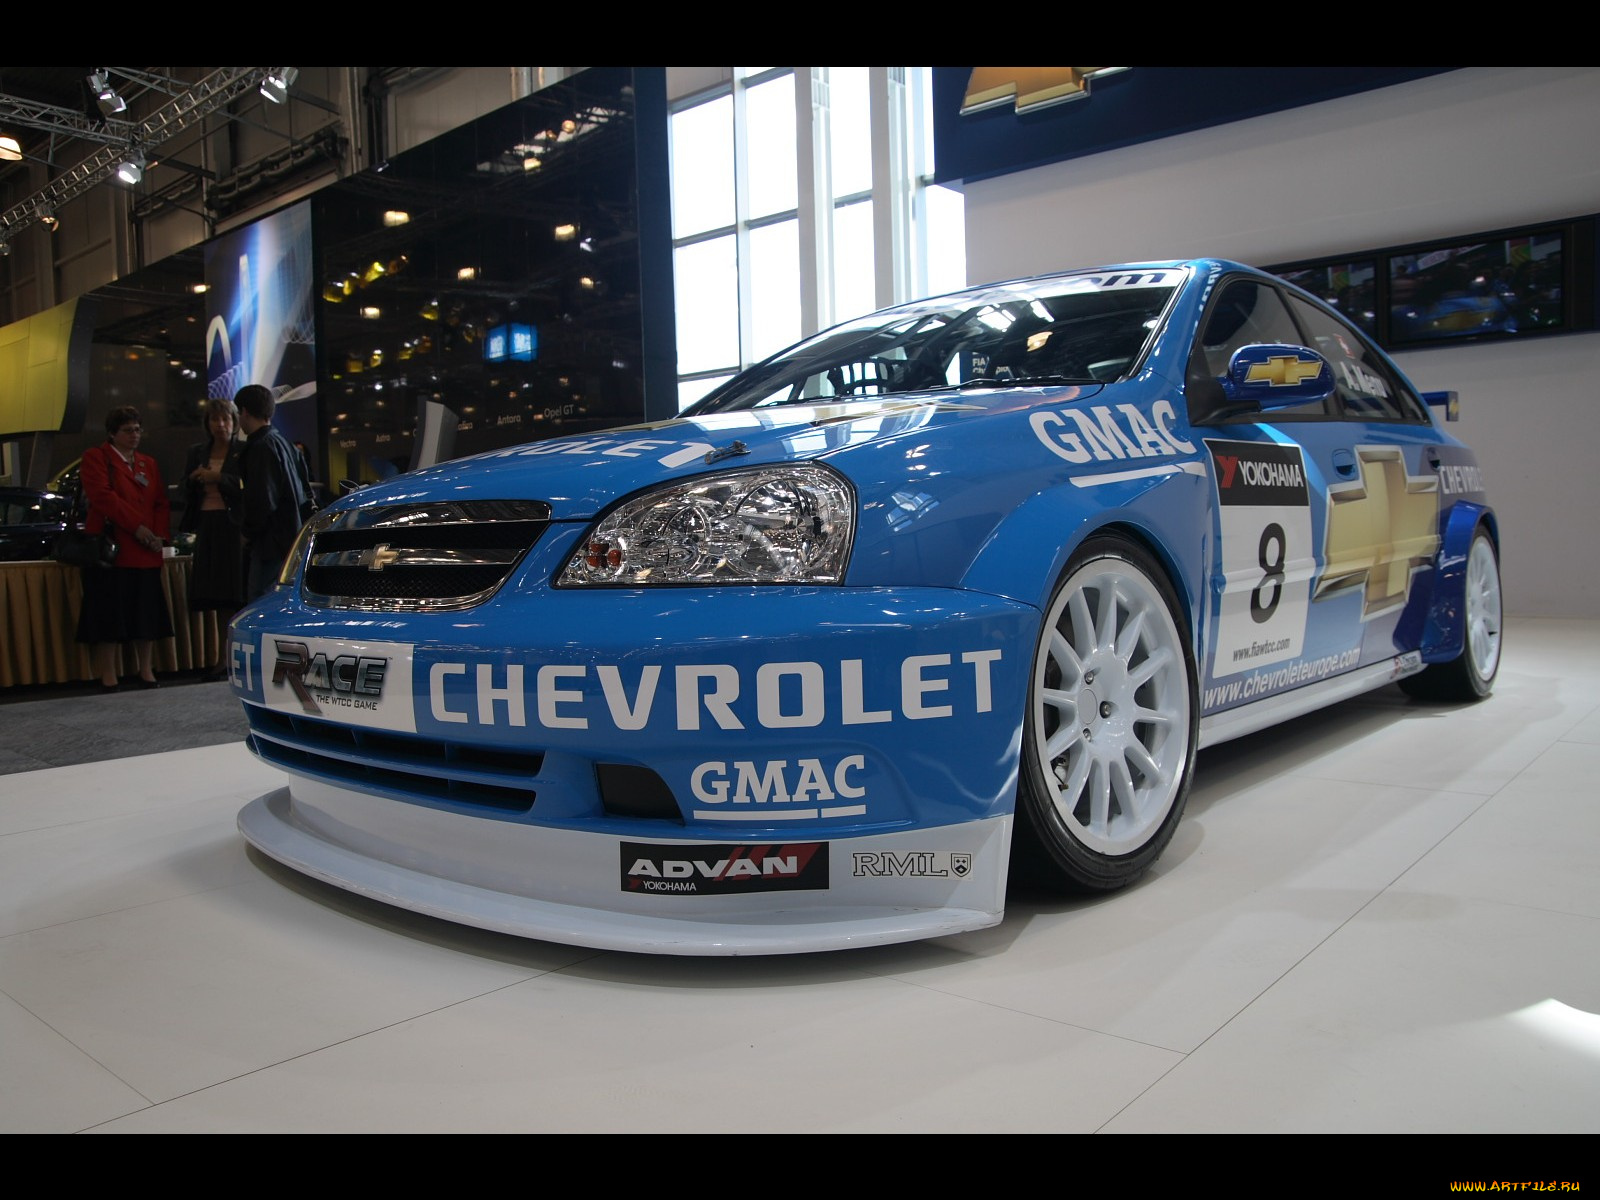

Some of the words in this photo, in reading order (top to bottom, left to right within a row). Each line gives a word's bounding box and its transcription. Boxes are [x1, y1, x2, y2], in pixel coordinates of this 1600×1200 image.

[544, 406, 562, 419] Opel
[563, 404, 574, 415] GT
[1029, 400, 1197, 464] GMAC
[1238, 461, 1303, 487] YOKOHAMA
[1250, 523, 1286, 624] 8
[228, 641, 255, 692] ET
[1232, 638, 1291, 662] www.fiawtcc.com
[272, 639, 388, 716] RACE
[429, 649, 1003, 731] CHEVROLET
[1203, 648, 1360, 710] www.chevroleteurope.com
[316, 694, 330, 704] THE
[331, 696, 352, 707] WTCC
[354, 700, 378, 711] GAME
[691, 754, 867, 804] GMAC
[628, 856, 799, 878] ADVAN
[853, 852, 949, 878] RML
[643, 880, 697, 892] YOKOHAMA
